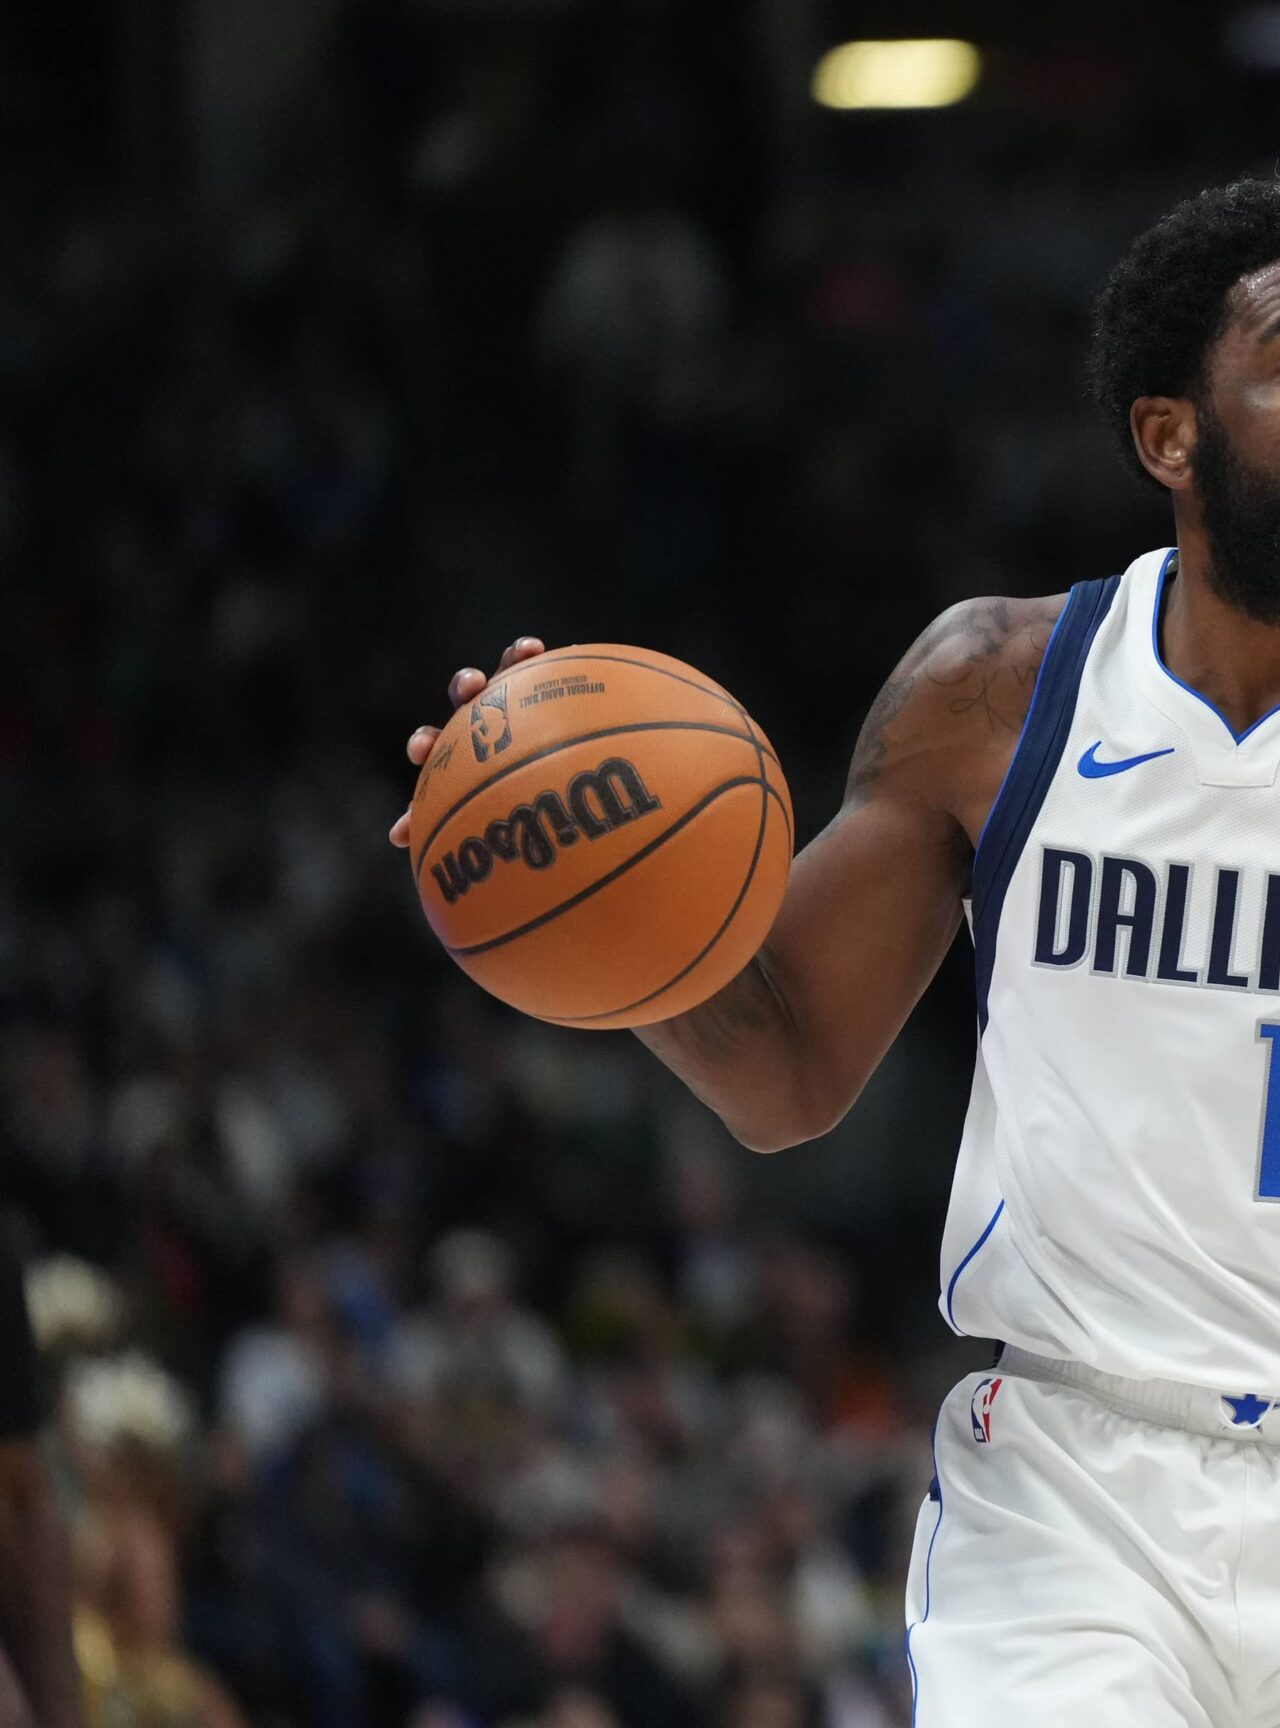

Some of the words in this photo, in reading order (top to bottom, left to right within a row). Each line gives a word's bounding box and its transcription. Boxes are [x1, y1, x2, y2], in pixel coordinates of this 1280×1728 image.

[541, 687, 564, 701] GAME
[568, 683, 604, 696] OFFICIAL
[430, 757, 662, 905] Wilson
